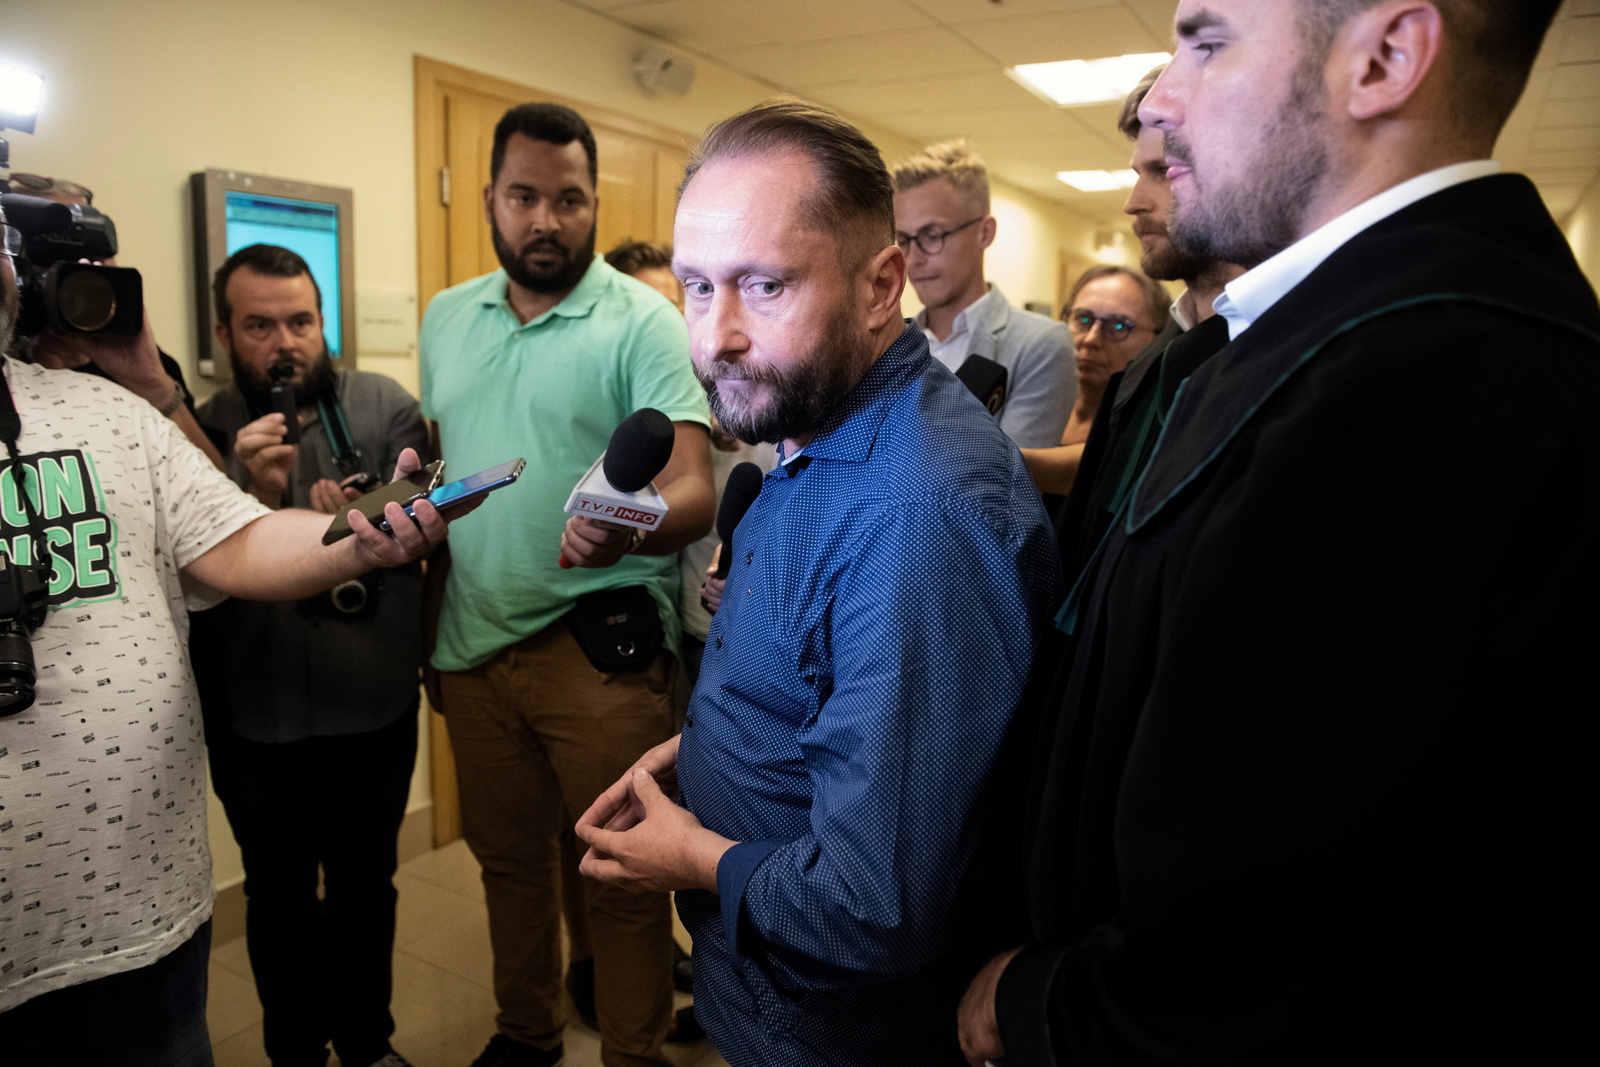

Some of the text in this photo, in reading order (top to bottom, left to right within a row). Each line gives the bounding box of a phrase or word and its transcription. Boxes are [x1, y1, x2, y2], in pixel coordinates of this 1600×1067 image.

[0, 456, 86, 528] ON
[581, 500, 655, 523] TVP INFO
